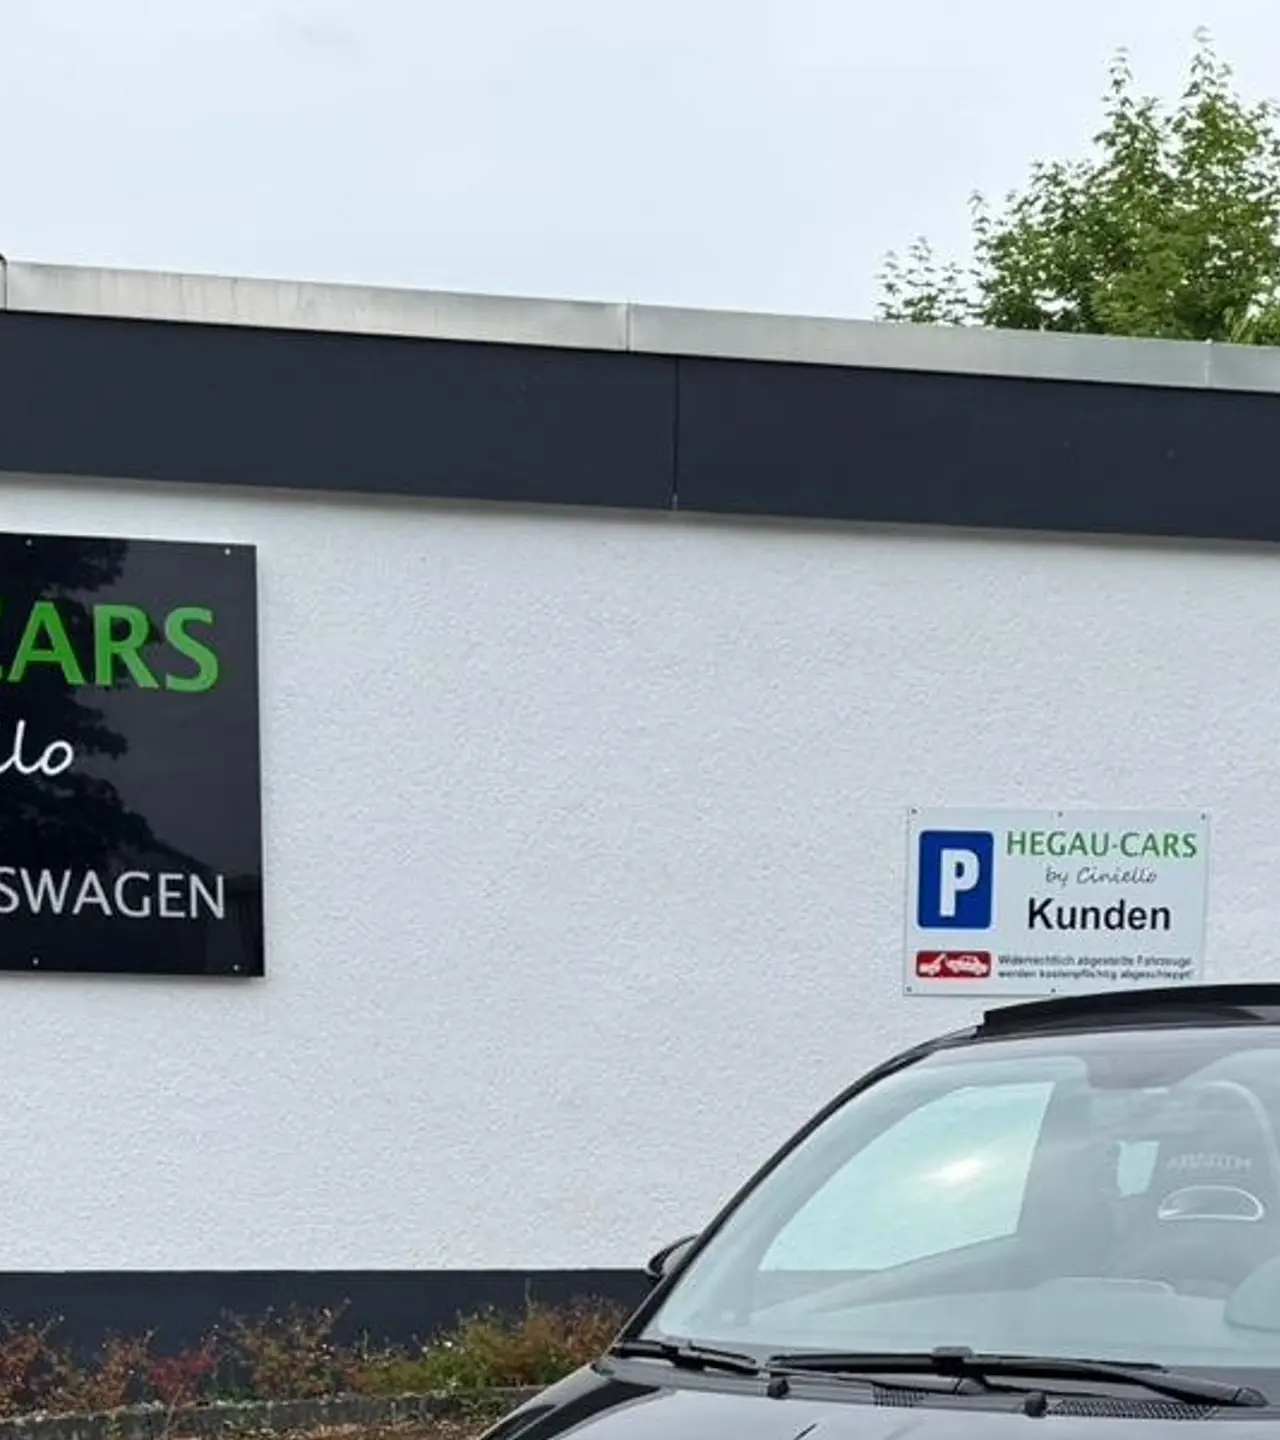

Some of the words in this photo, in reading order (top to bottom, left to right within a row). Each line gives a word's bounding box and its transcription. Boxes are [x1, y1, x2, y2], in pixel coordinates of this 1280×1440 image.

[1006, 830, 1198, 859] HEGAU-CARS
[939, 849, 979, 917] P
[1045, 865, 1069, 888] by
[1076, 866, 1158, 885] Ciniello
[1028, 897, 1171, 931] Kunden
